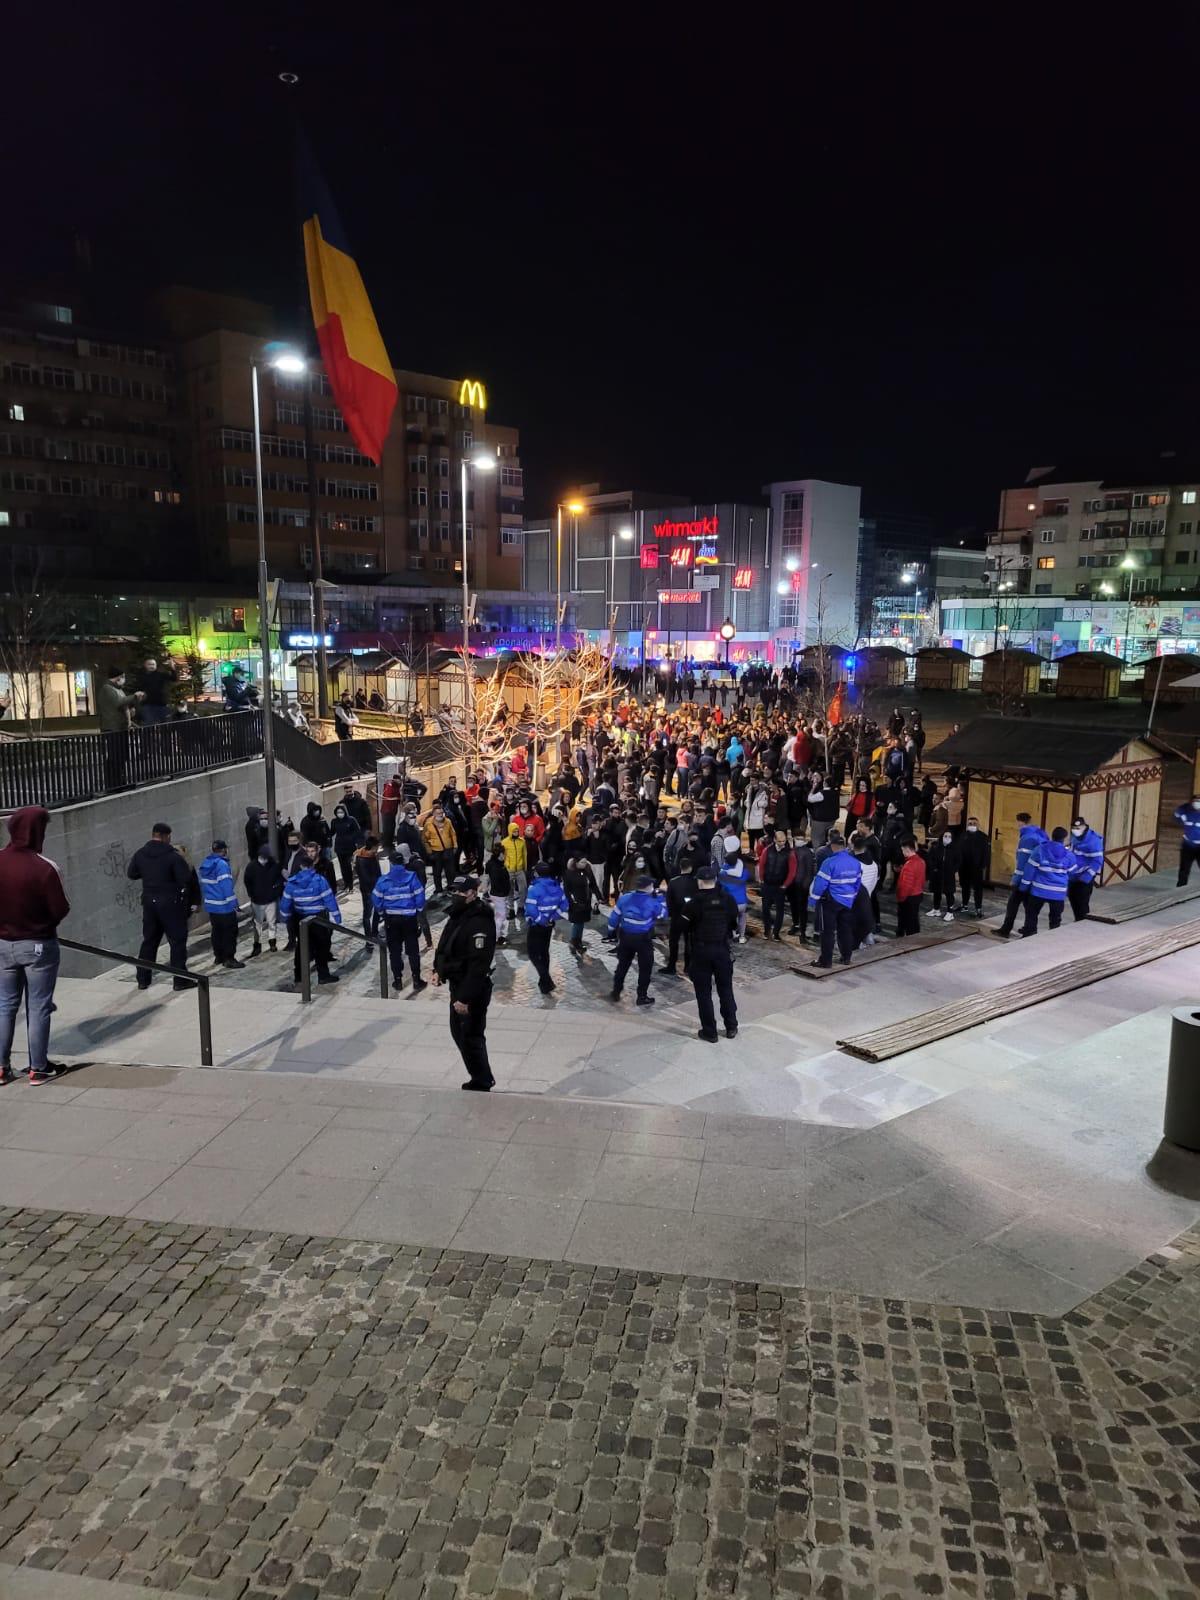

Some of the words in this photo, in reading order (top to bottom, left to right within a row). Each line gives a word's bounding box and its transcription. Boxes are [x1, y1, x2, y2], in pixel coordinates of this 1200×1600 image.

[653, 517, 718, 537] winmarkt
[699, 544, 716, 557] dm
[670, 591, 700, 602] market
